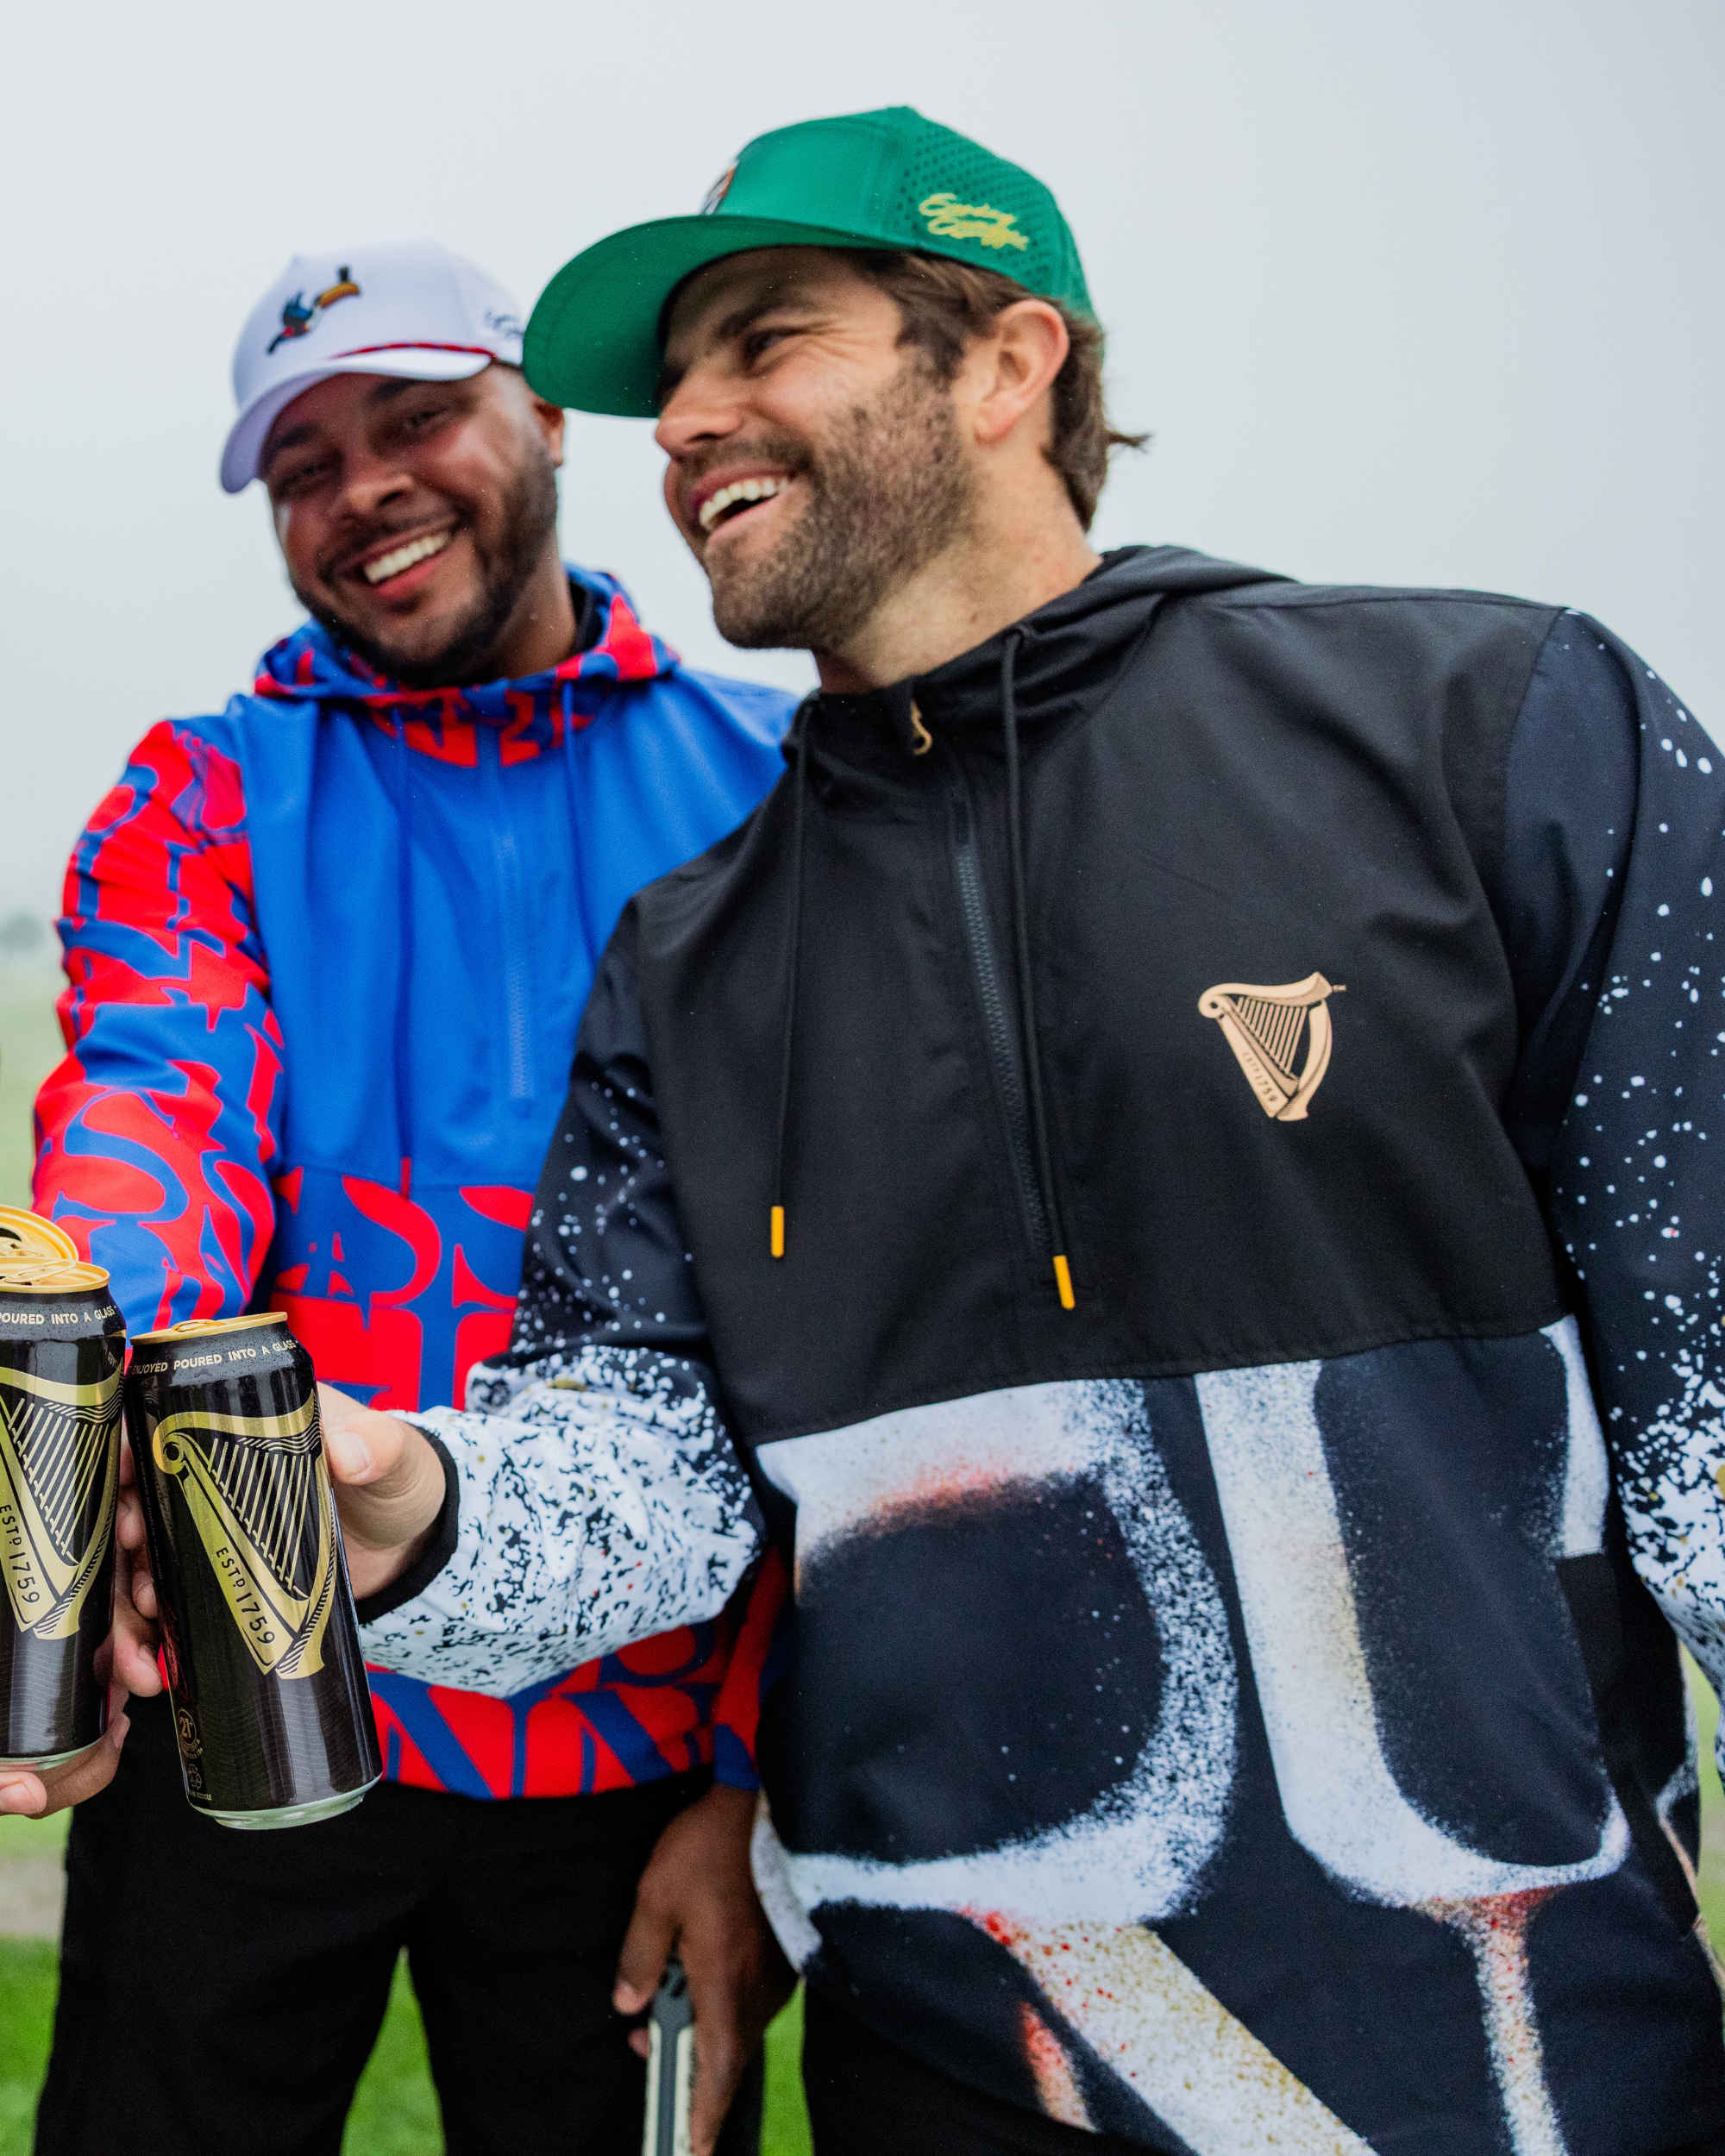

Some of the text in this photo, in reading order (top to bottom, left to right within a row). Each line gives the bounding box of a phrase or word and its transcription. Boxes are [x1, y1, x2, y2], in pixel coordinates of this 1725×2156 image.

[0, 1306, 115, 1325] OURED INTO A GLASS
[173, 1354, 223, 1370] POURED
[229, 1348, 257, 1362] INTO
[262, 1345, 271, 1356] A
[273, 1339, 298, 1352] GLASS
[9, 1551, 41, 1604] 1759
[235, 1592, 276, 1645] 1759
